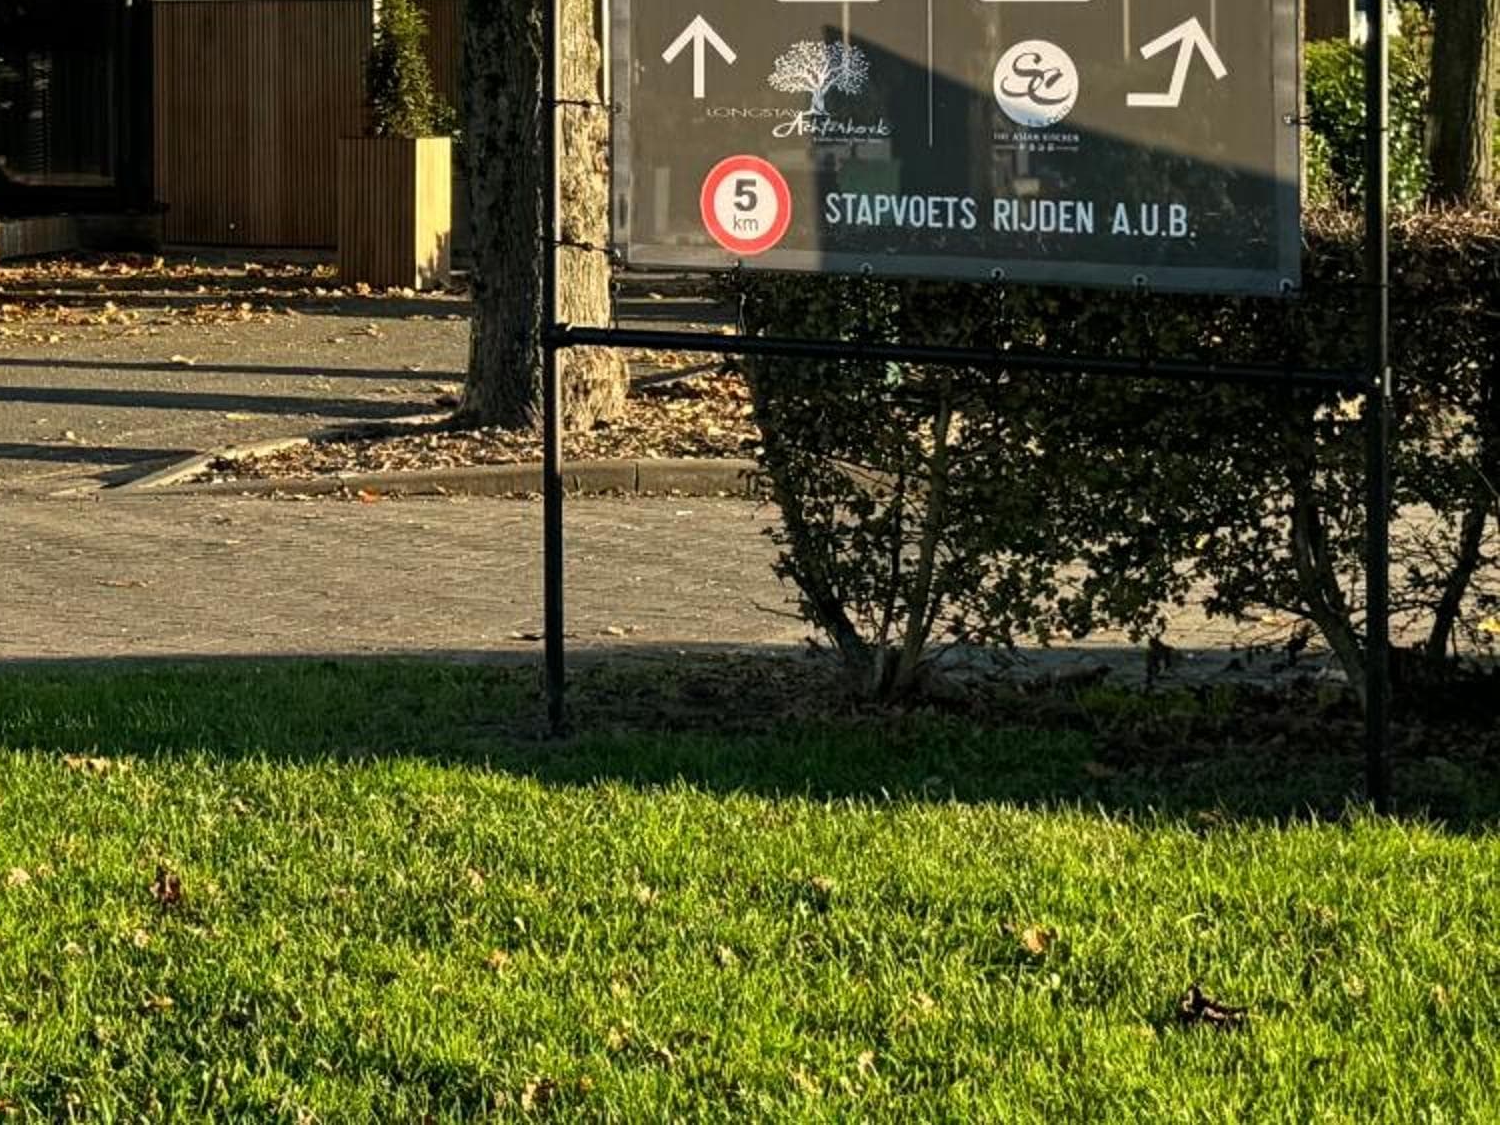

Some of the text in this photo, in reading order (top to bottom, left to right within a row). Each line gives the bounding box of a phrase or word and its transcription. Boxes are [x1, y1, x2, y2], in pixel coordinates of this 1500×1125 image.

[706, 106, 802, 119] LONGSTAY
[733, 178, 759, 212] 5
[732, 212, 760, 233] km
[824, 192, 1198, 239] STAPVOETS RIJDEN A.U.B.
